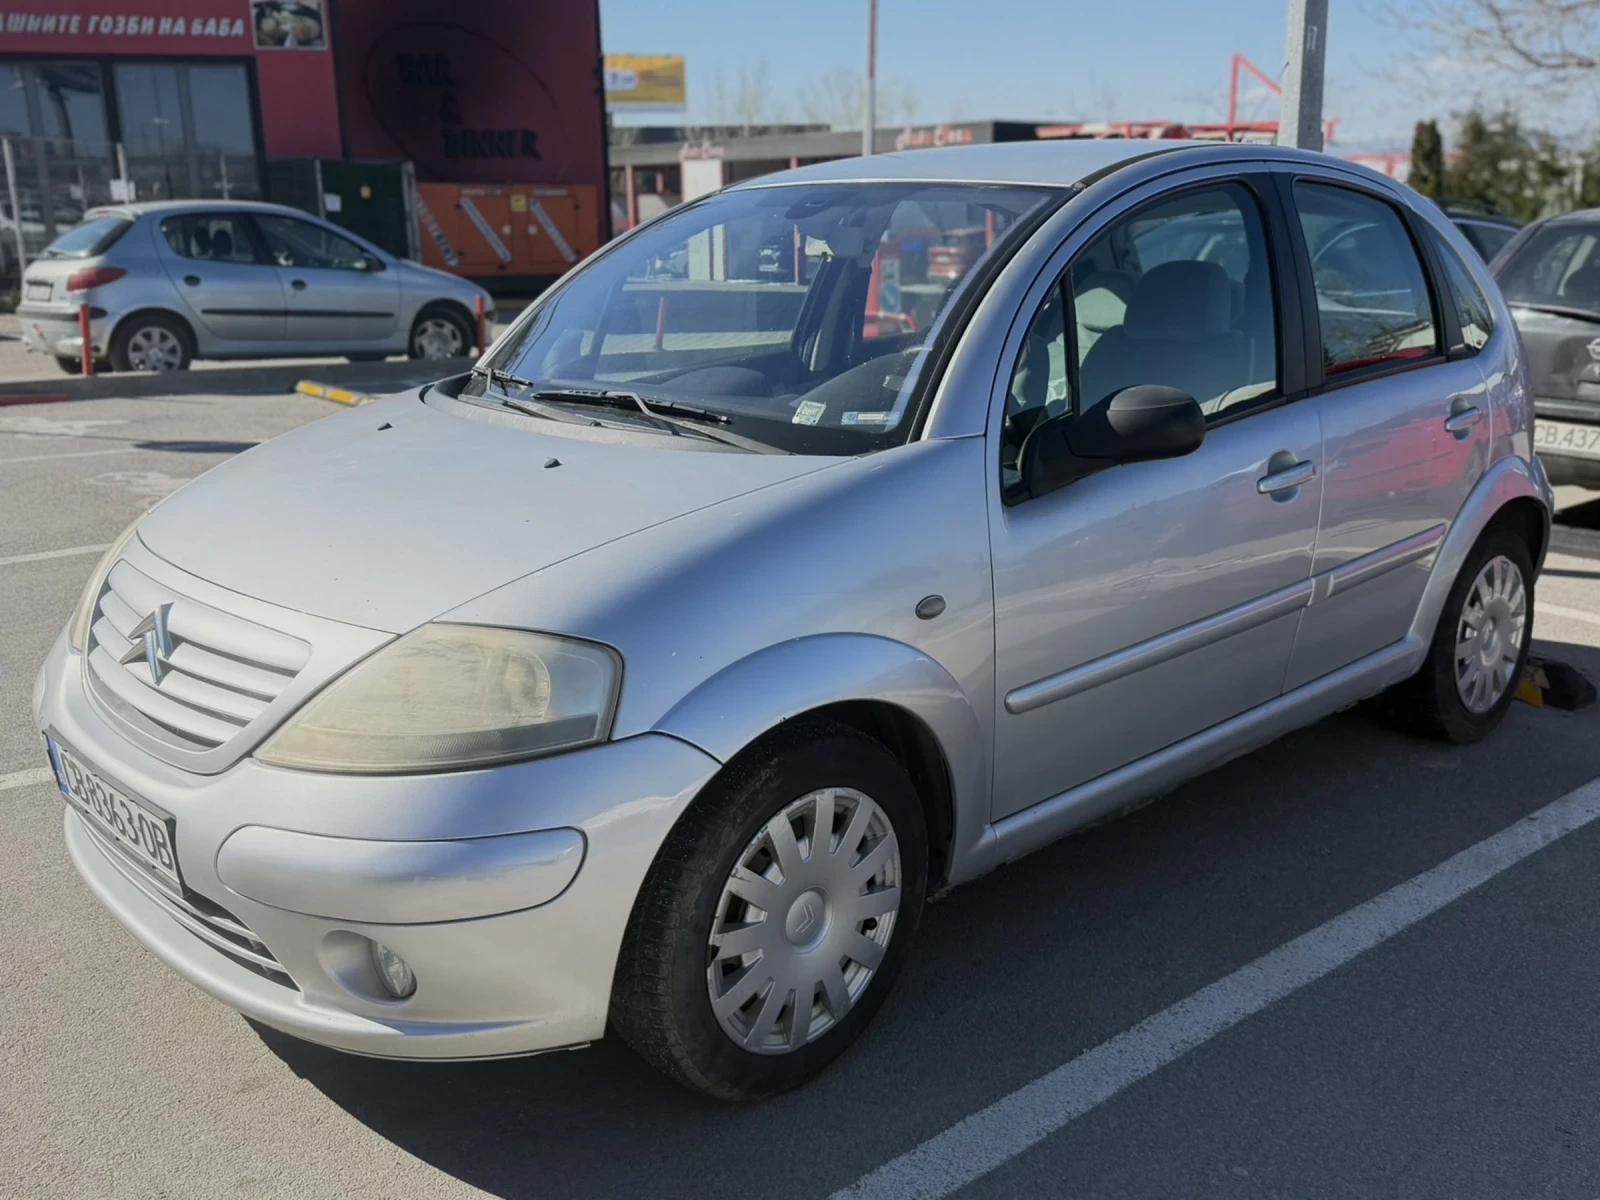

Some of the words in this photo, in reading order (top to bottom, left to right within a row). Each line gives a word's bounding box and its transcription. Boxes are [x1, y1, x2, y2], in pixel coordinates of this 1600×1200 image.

[87, 14, 155, 36] ГОЗБИ
[158, 15, 187, 36] НА
[190, 16, 246, 37] БАБА
